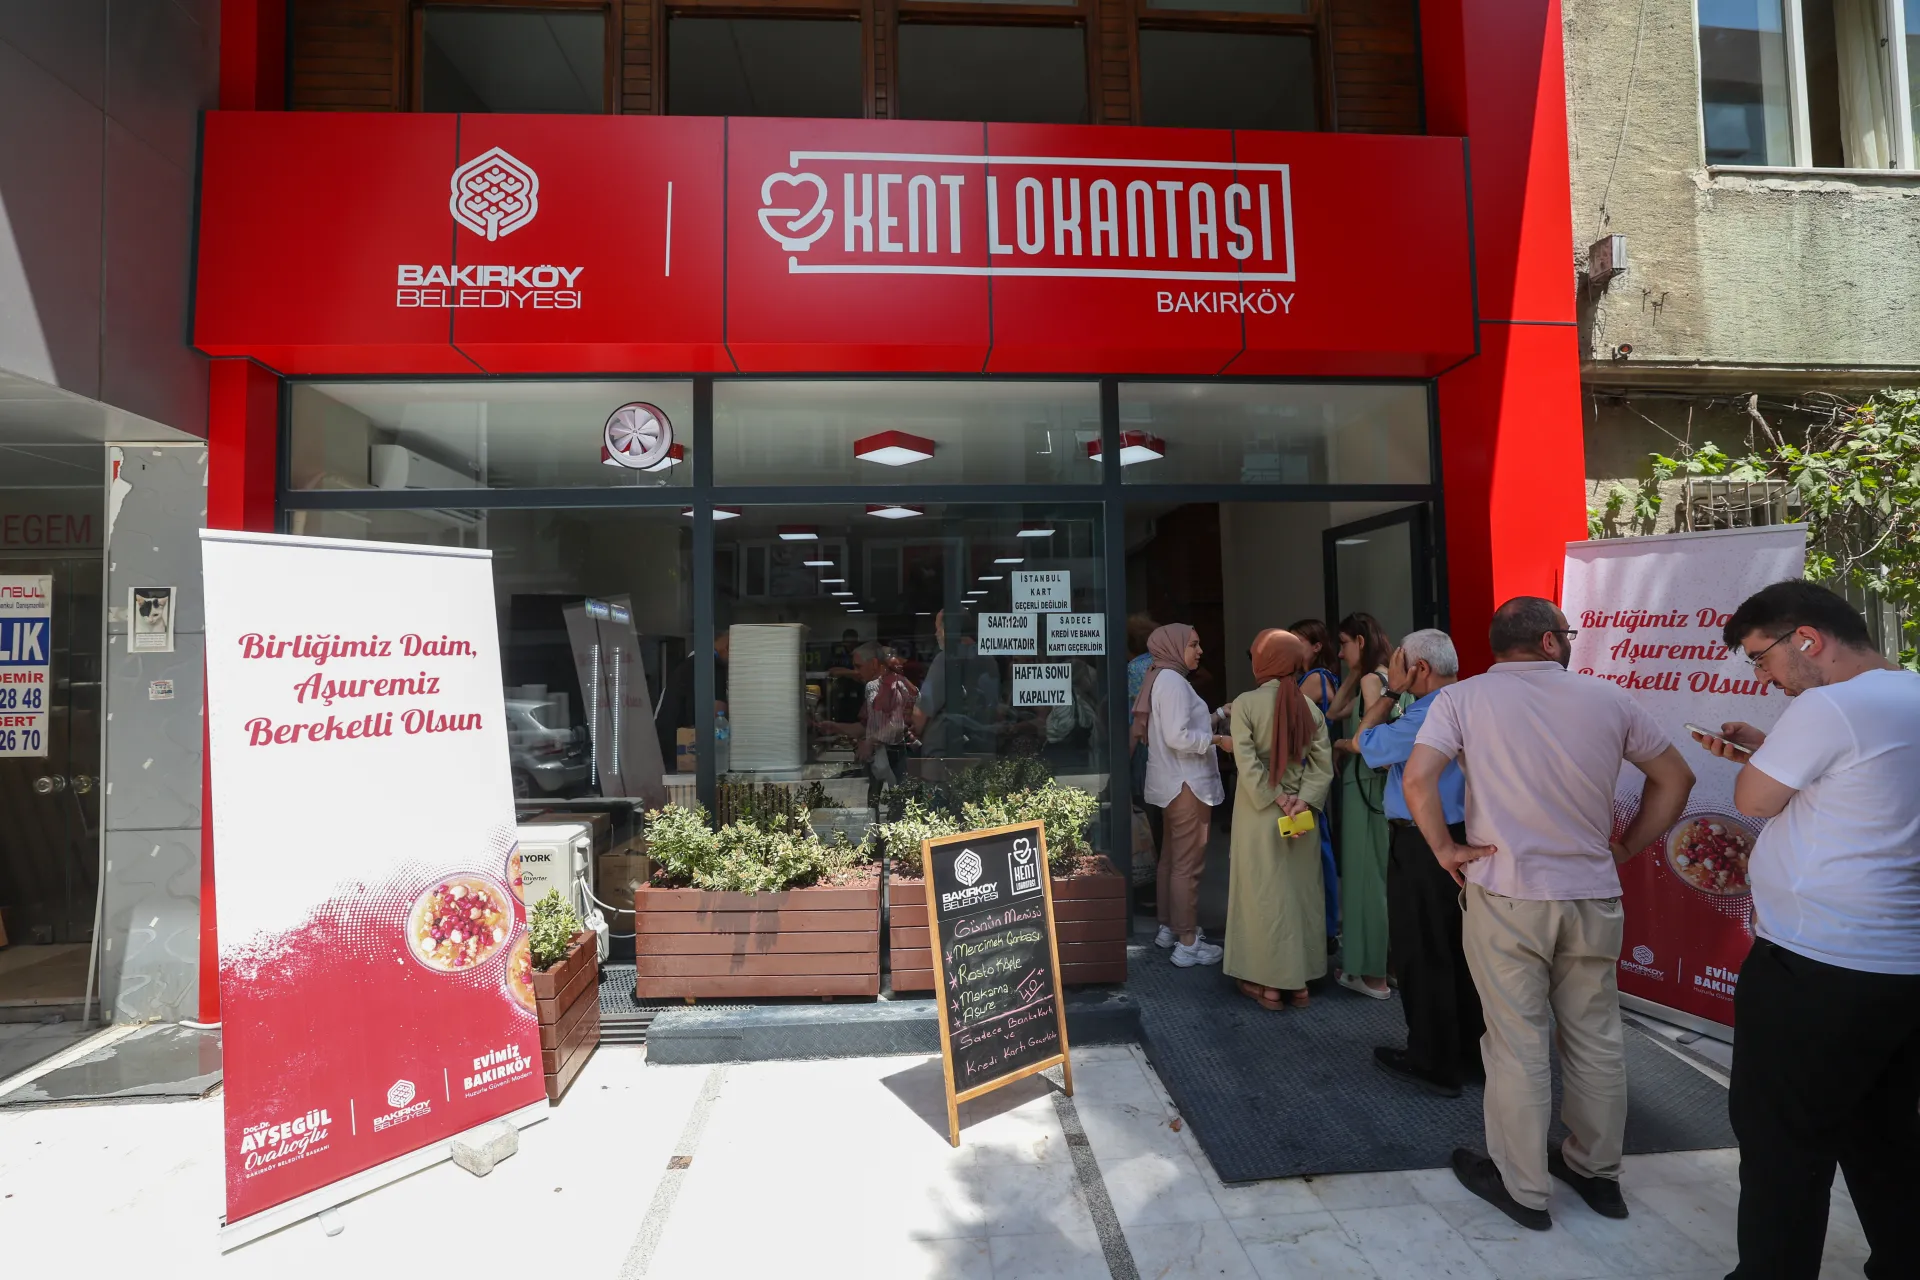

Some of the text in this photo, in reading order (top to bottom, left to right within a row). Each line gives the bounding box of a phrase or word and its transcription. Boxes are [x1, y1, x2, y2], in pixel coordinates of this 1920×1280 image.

[844, 172, 1273, 261] KENT LOKANTASI
[397, 264, 584, 287] BAKIRKÖY
[1156, 288, 1296, 314] BAKIRKÖY
[1020, 573, 1061, 582] İSTANBUL
[1030, 588, 1052, 596] KART
[1015, 599, 1068, 611] GEÇERLİ DEĞİLDİR
[988, 615, 1028, 628] SAAT:12:00
[1059, 616, 1092, 625] SADECE
[1580, 607, 1731, 634] Birliğimiz Da
[1051, 628, 1100, 638] KREDİ VE BANKA
[238, 632, 477, 666] Birliğimiz Daim,
[980, 638, 1035, 653] AÇILMAKTADIR
[1048, 642, 1103, 653] KARTI GEÇERLİDİR
[1610, 638, 1729, 664] Aşuremiz
[1014, 665, 1070, 680] HAFTA SONU
[1687, 671, 1769, 696] Olsun
[22, 688, 42, 709] 48
[293, 671, 440, 707] Aşuremiz
[1019, 690, 1066, 704] KAPALIYIZ
[244, 708, 483, 746] Bereketli Olsun
[21, 730, 41, 750] 70
[524, 854, 551, 862] YORK
[1014, 863, 1035, 882] KENT
[954, 905, 1042, 938] Günün Menüsü
[953, 933, 1005, 958] Mercimek
[1694, 974, 1736, 996] BAKIR
[1705, 965, 1739, 983] EVİM
[959, 984, 1009, 1007] Makarna
[1019, 979, 1038, 1003] 40
[962, 1001, 996, 1023] Aşure
[959, 1027, 1003, 1050] Sadece
[1004, 1031, 1016, 1040] ve
[473, 1043, 520, 1071] EVİMİZ
[966, 1055, 998, 1076] Kredi
[463, 1055, 532, 1090] BAKIRKÖY
[240, 1109, 332, 1155] AYŞEGÜL
